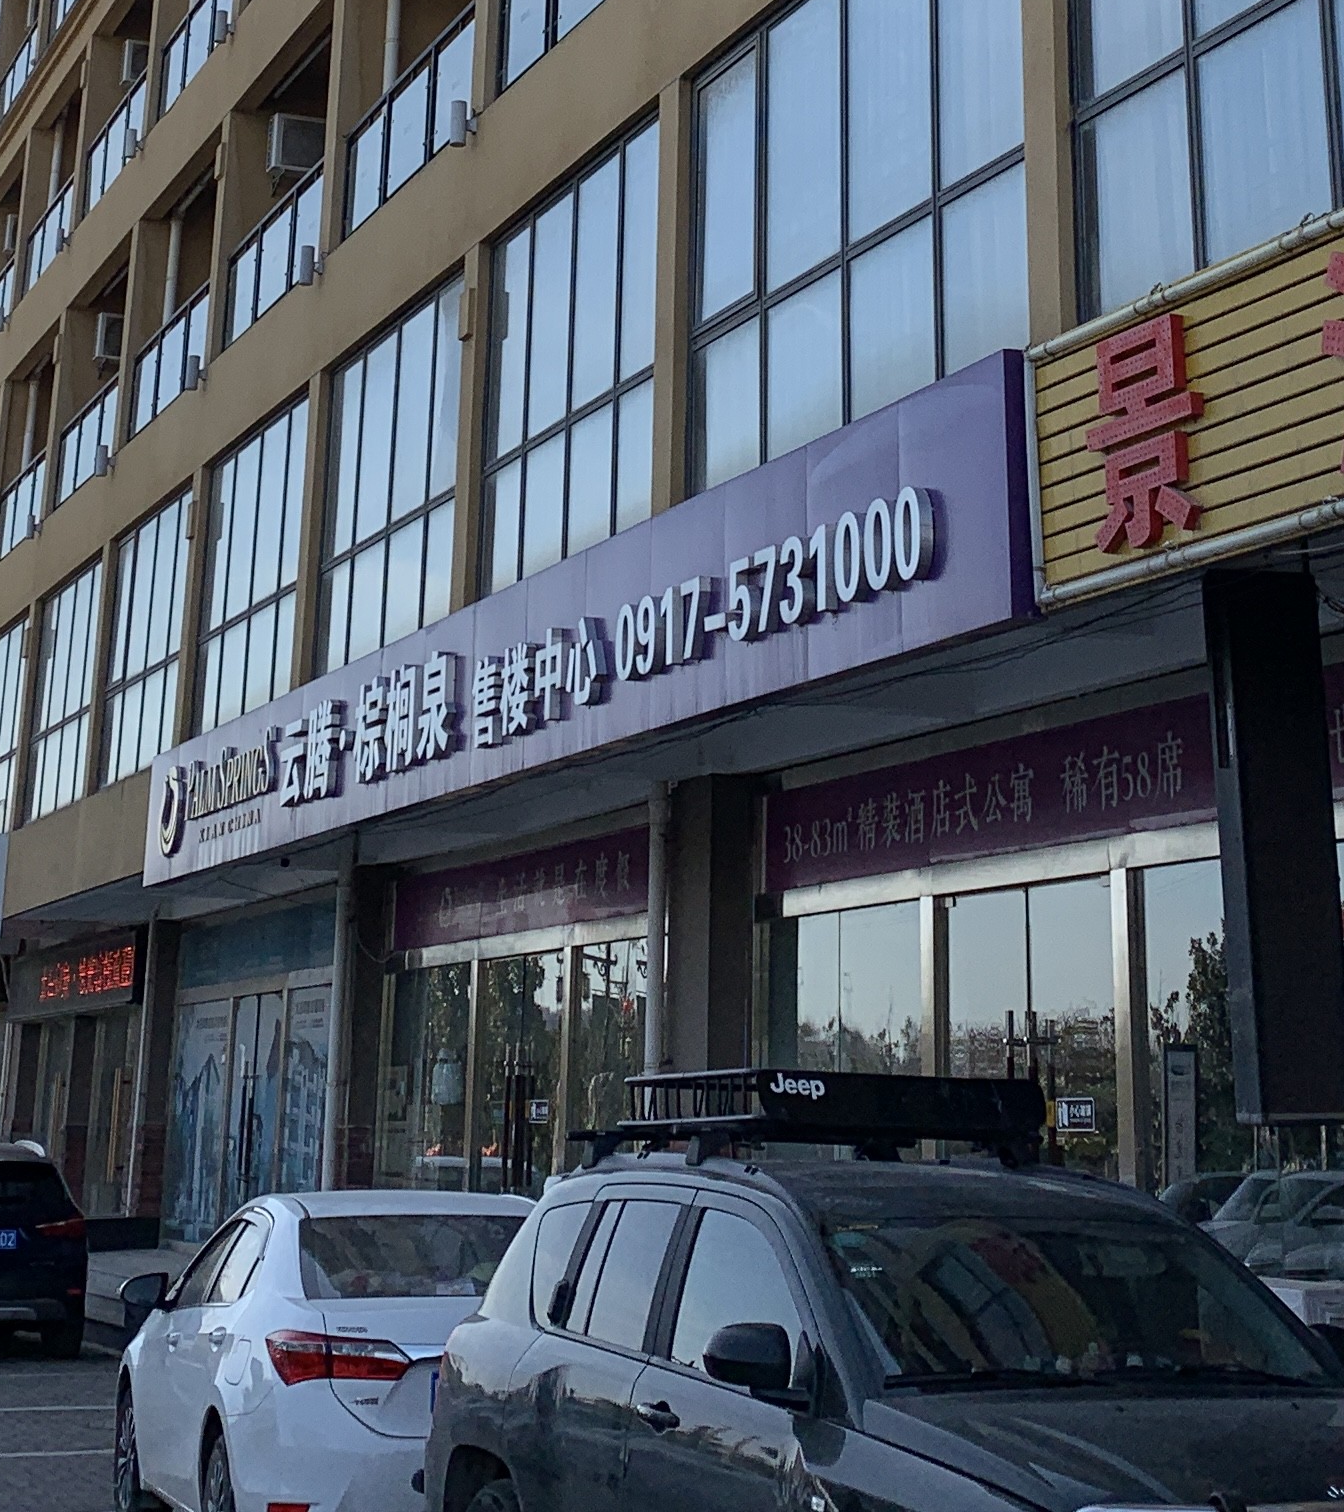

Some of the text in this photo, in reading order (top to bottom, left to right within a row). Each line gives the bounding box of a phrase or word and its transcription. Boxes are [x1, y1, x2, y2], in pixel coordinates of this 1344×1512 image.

[470, 615, 606, 751] 售楼中心
[616, 485, 933, 683] 0917-5731000
[769, 1070, 827, 1101] Jeep
